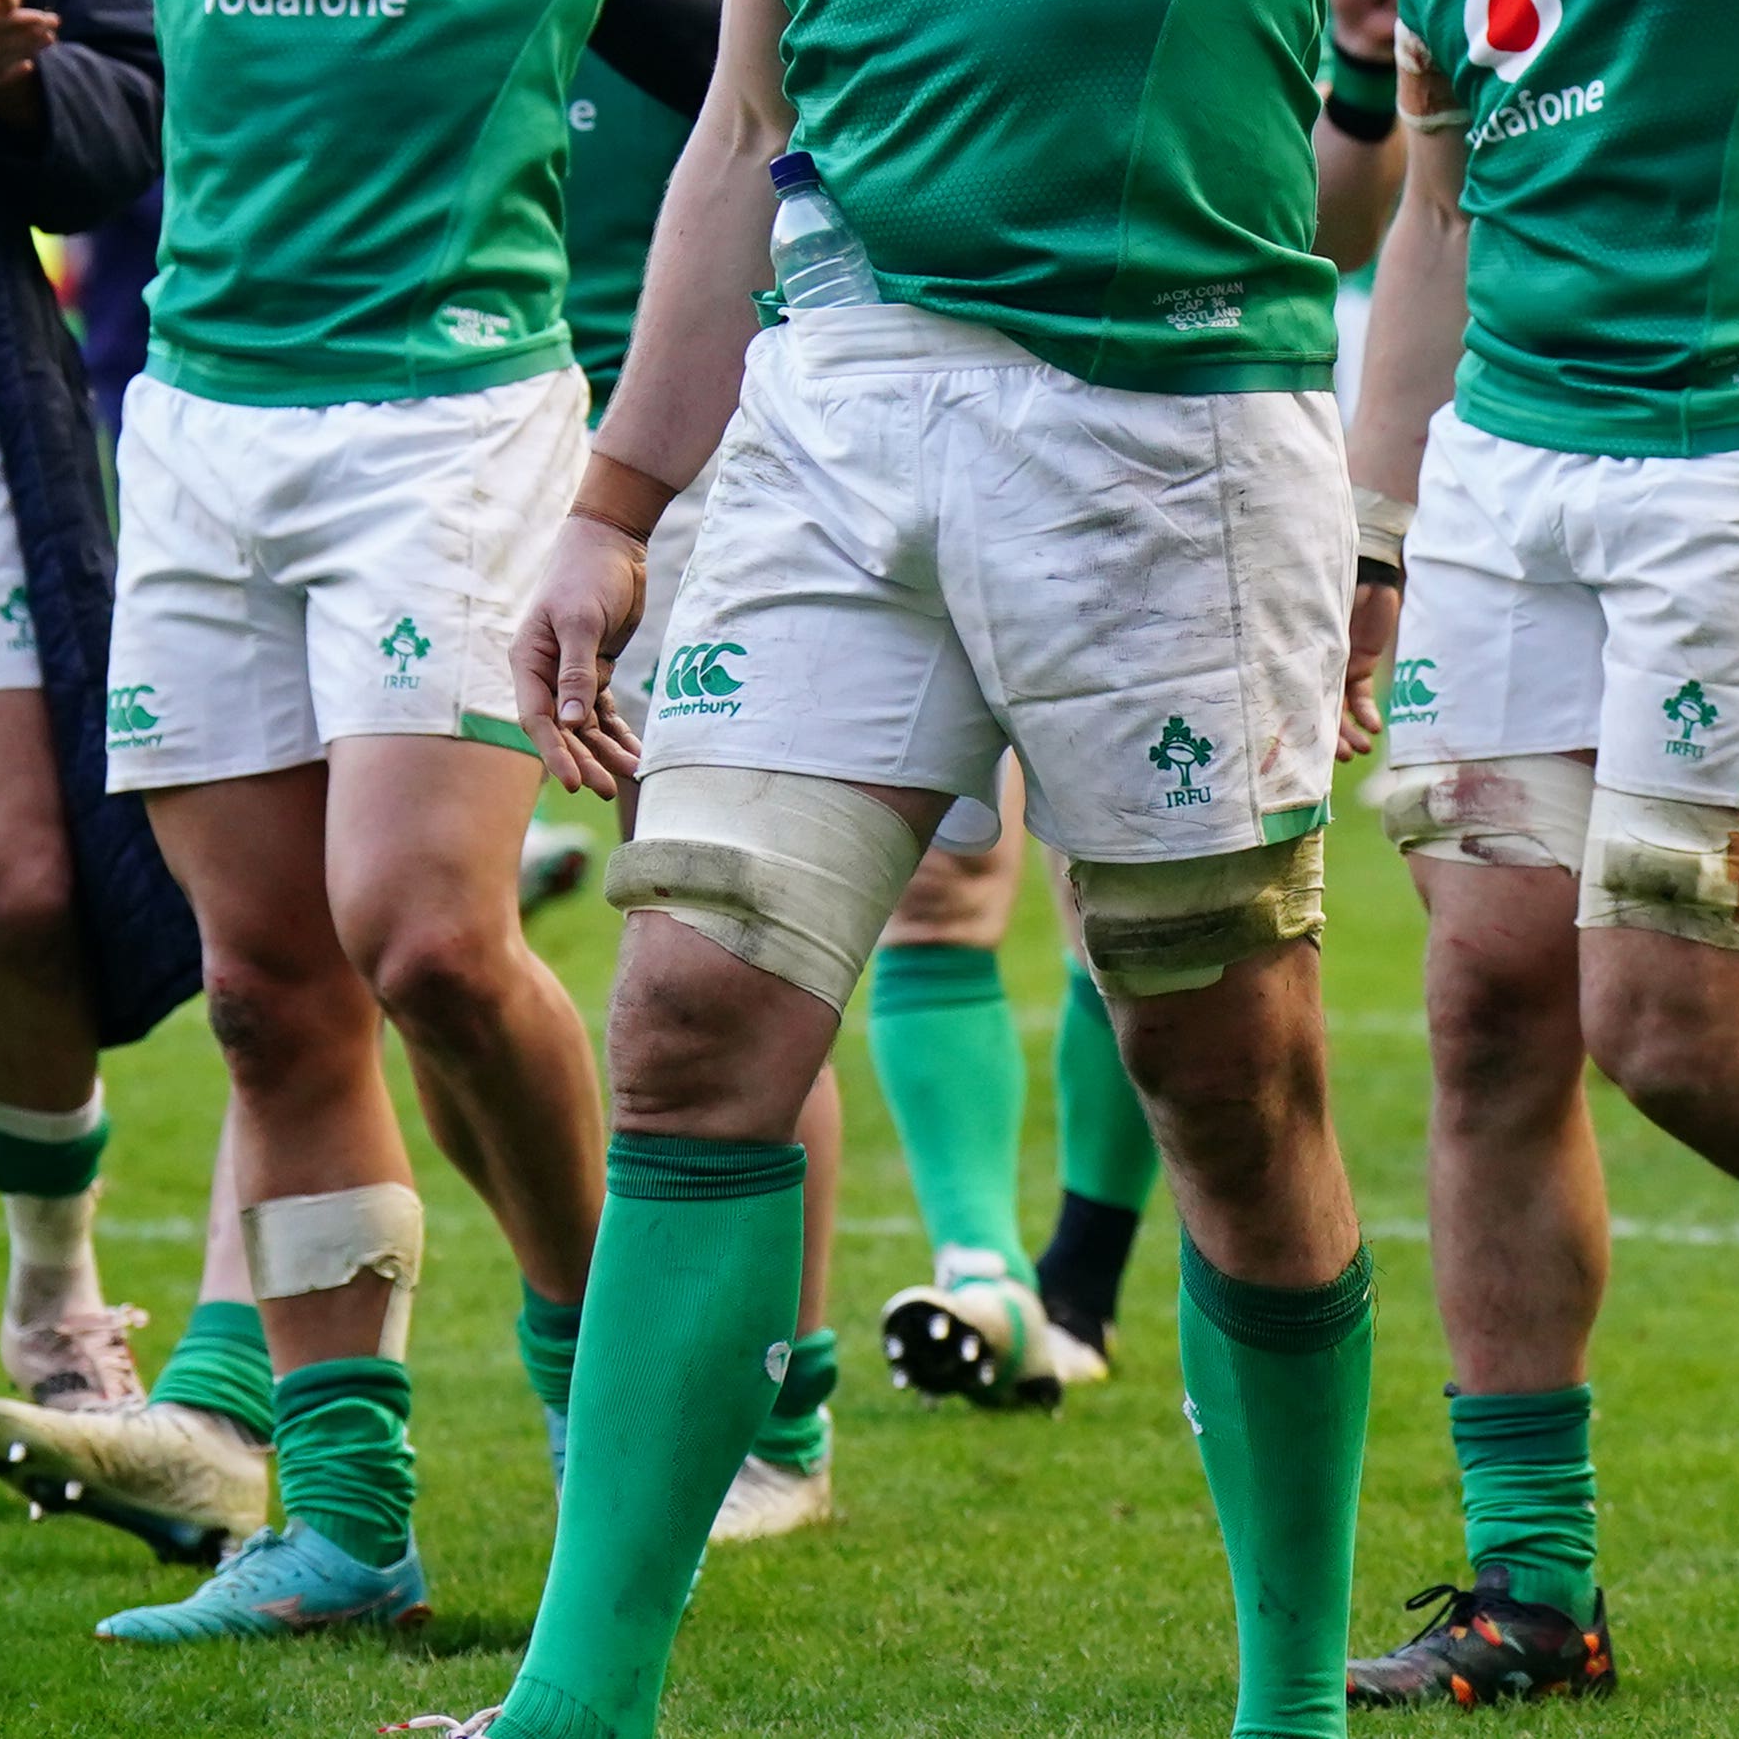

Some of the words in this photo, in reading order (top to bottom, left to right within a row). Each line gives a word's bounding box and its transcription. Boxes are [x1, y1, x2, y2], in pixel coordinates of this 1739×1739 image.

[1152, 288, 1192, 306] JACK
[1196, 281, 1244, 298] CONAN
[1166, 307, 1242, 324] SCOTLAND
[1174, 299, 1204, 313] CAP
[384, 674, 421, 690] IRFU
[658, 699, 742, 720] canterbury
[1166, 785, 1212, 809] IRFU
